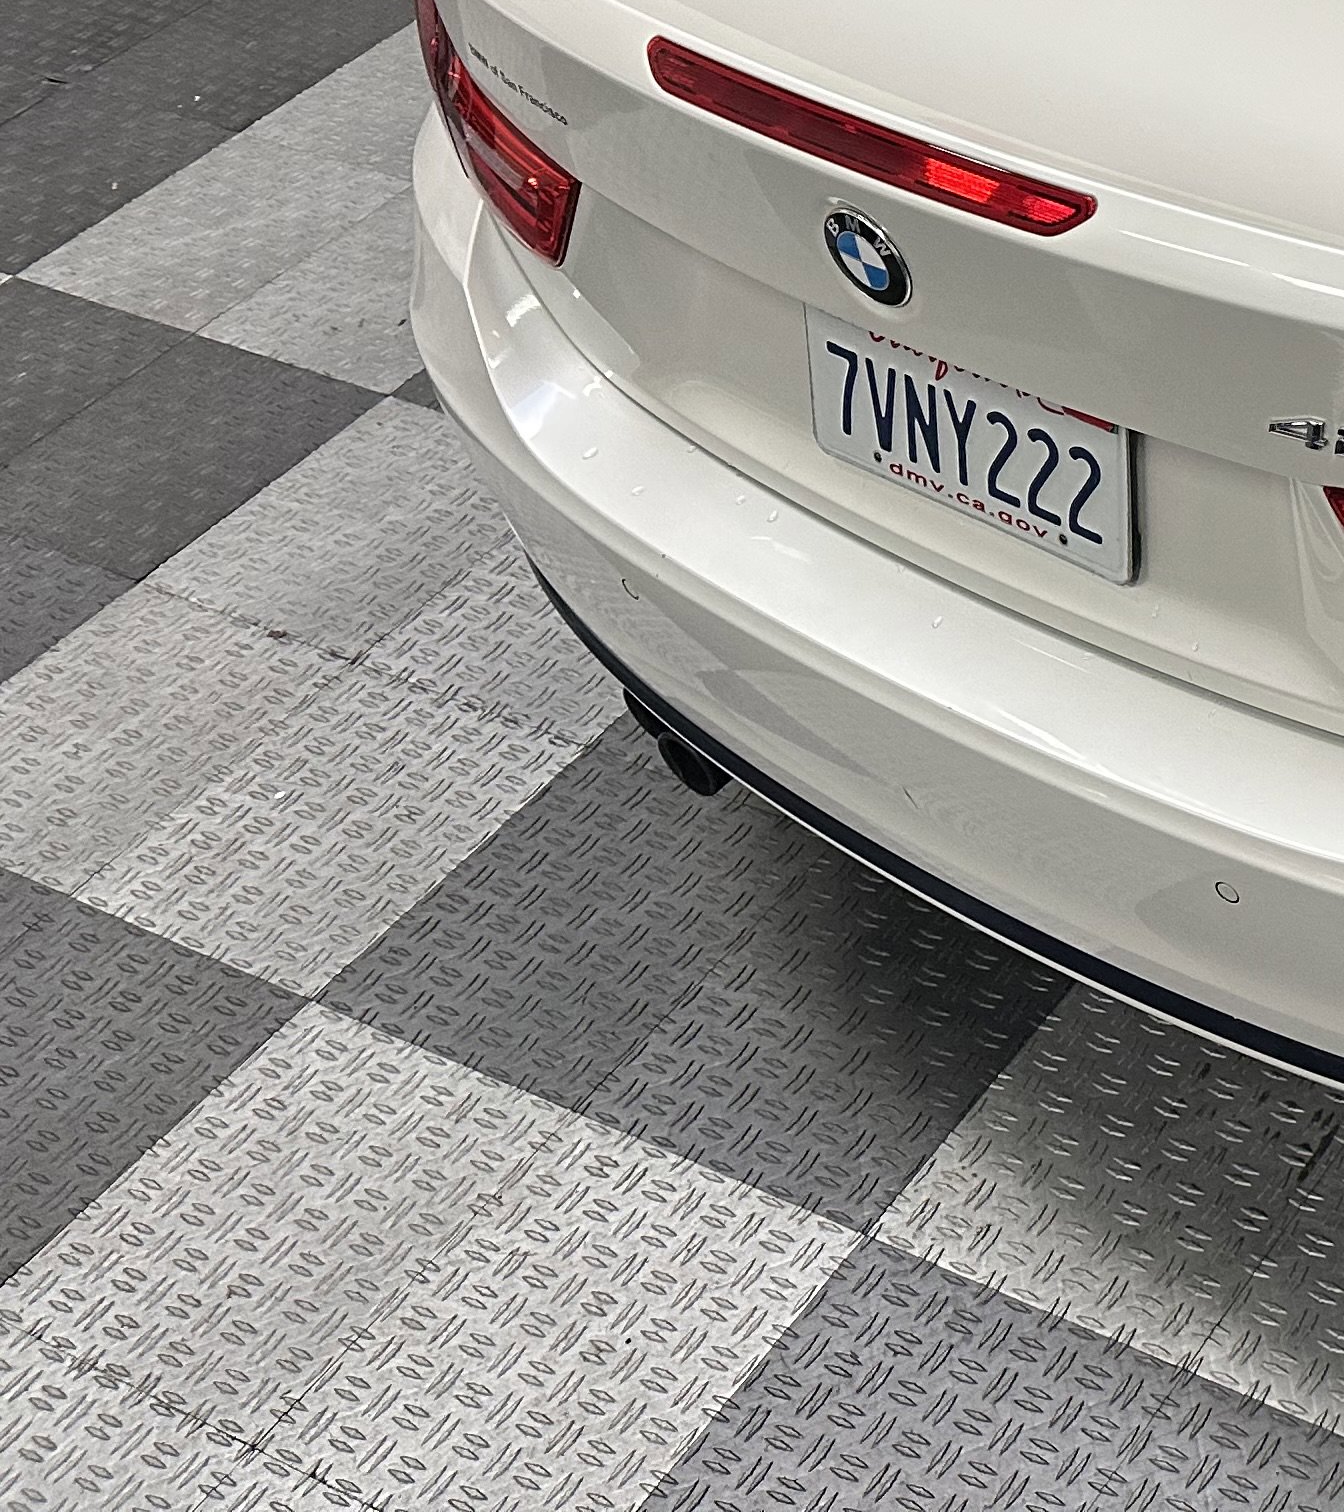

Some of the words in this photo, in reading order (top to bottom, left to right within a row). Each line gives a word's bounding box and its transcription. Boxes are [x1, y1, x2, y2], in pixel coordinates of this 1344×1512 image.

[826, 213, 892, 258] BMW
[825, 340, 1103, 545] 7VNY222
[888, 461, 1049, 539] dmv.ca.gov
